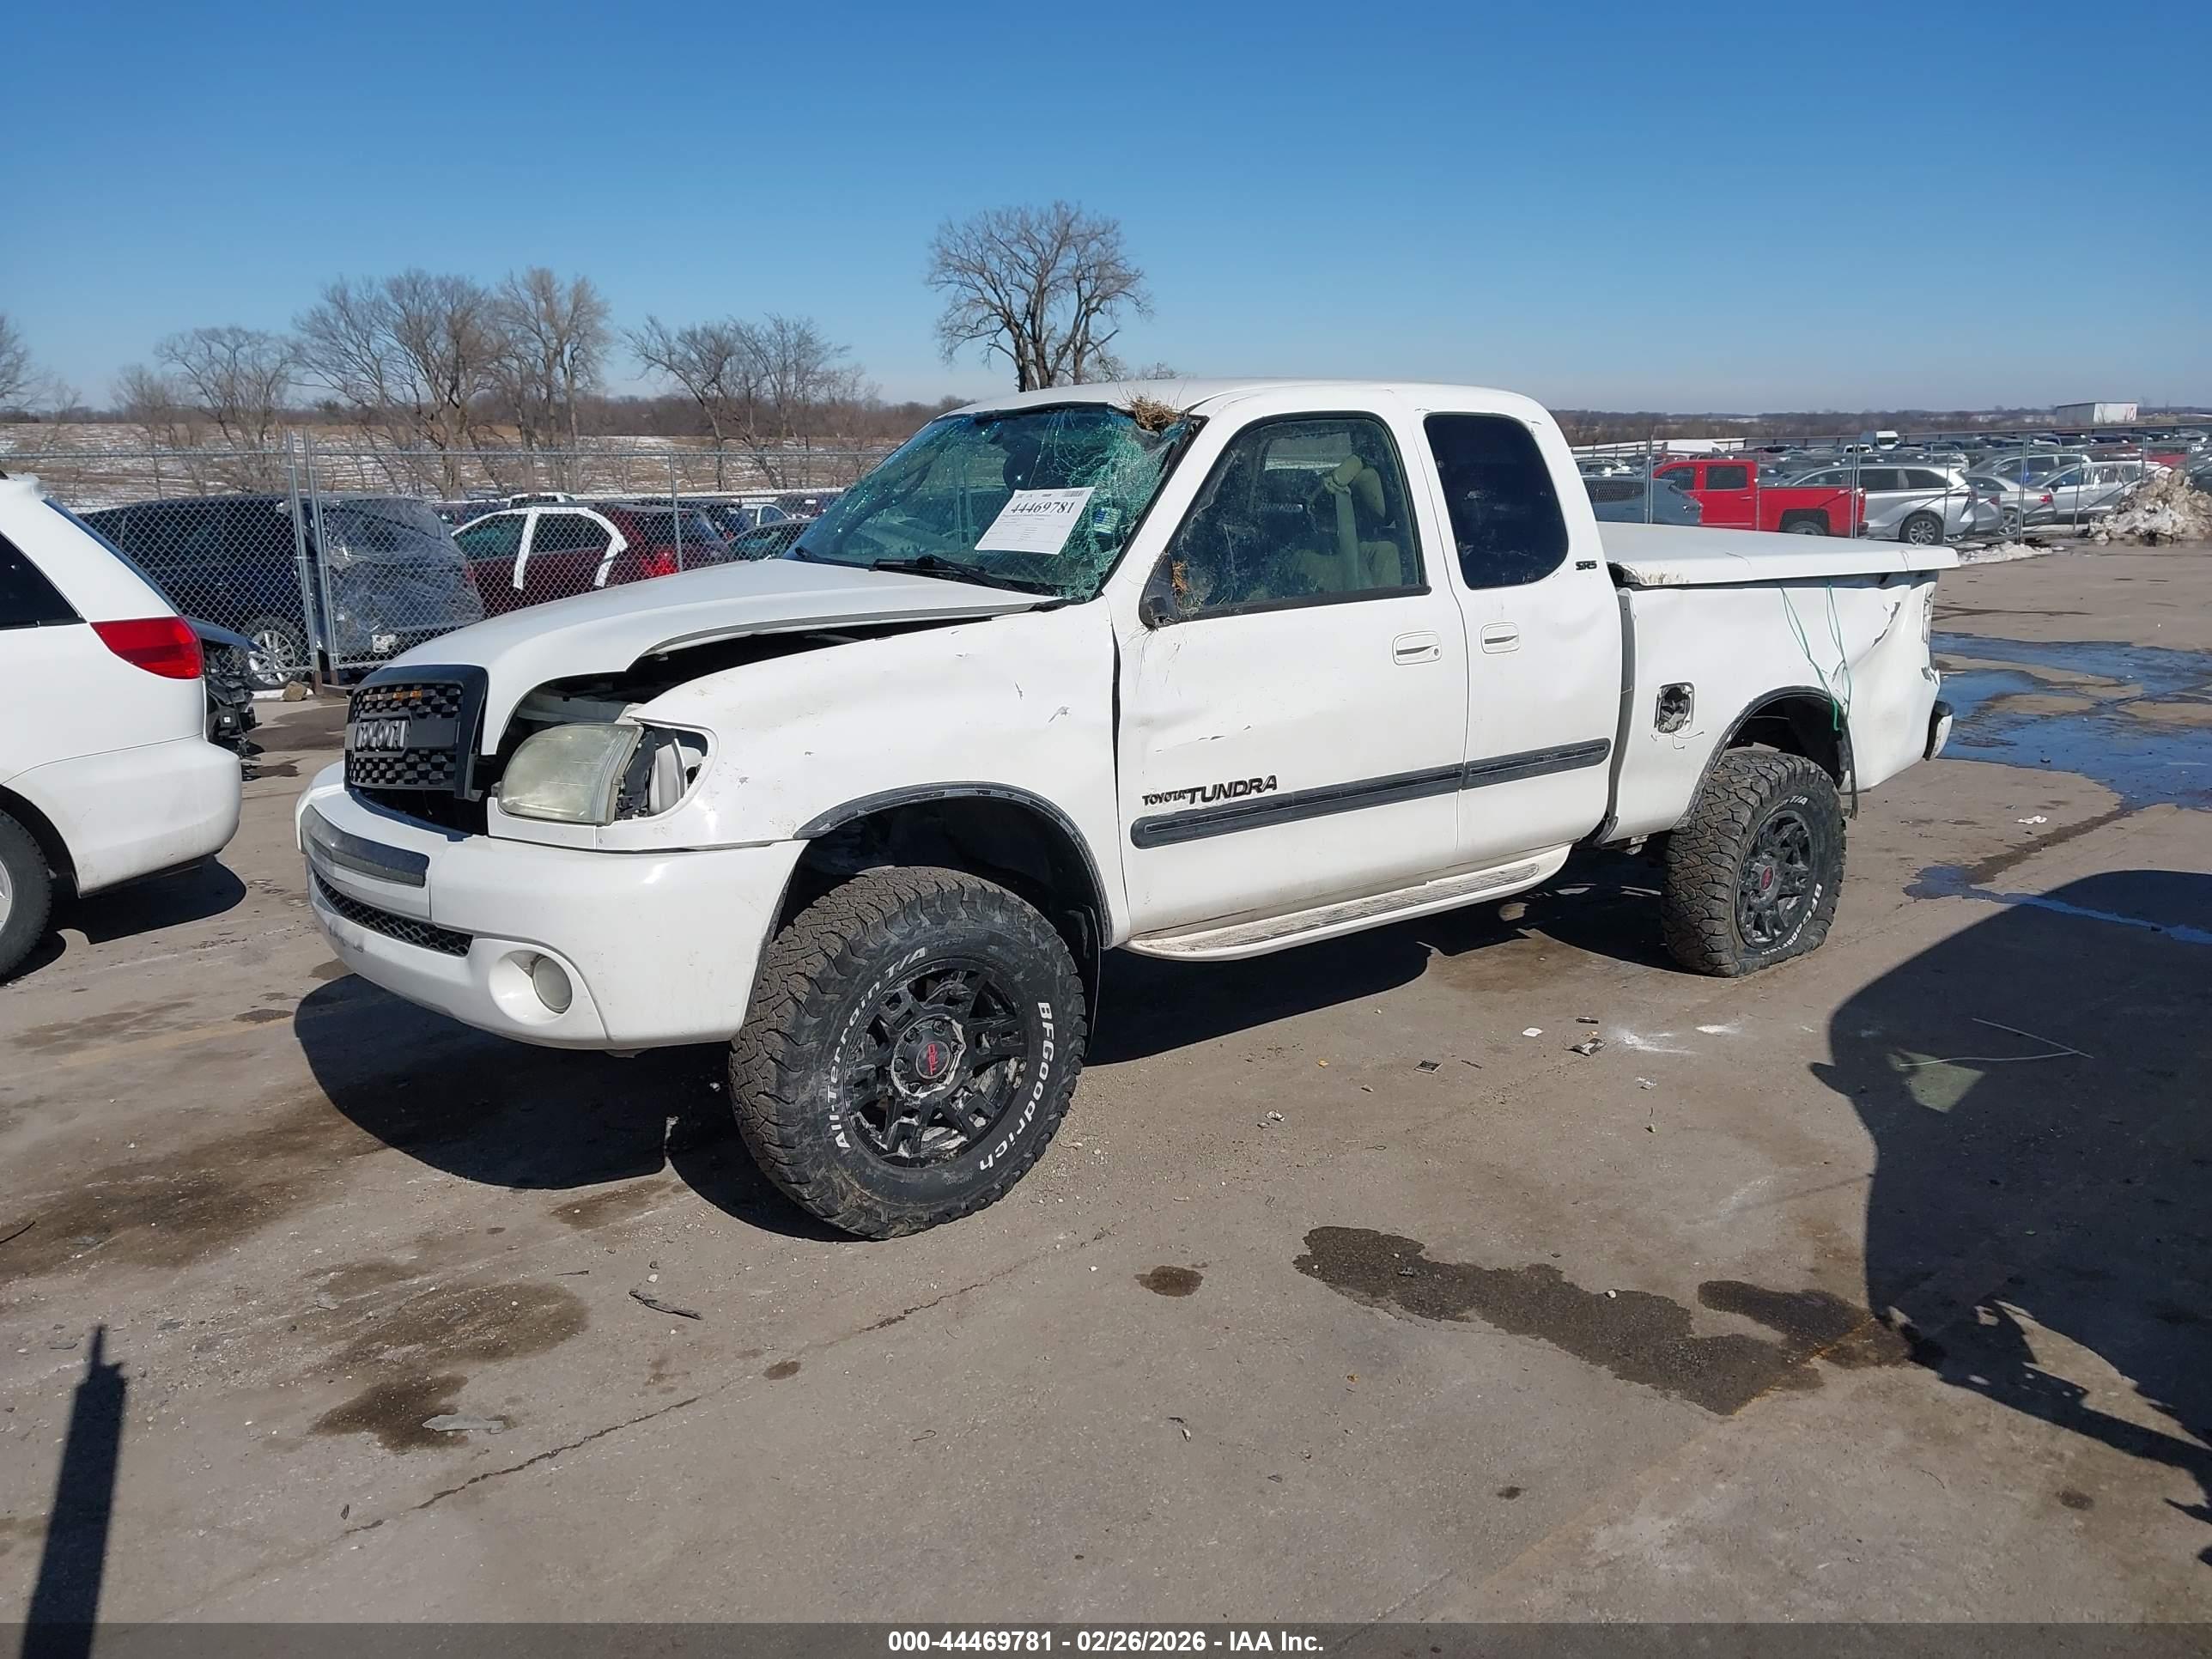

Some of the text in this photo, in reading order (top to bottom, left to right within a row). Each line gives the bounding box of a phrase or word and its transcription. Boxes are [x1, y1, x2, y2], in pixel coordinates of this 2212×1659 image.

[1011, 501, 1076, 514] 44469781
[1142, 775, 1278, 805] TOYOTA TUNDRA
[884, 946, 927, 978] T/A
[980, 1001, 1054, 1172] BFGoodrich
